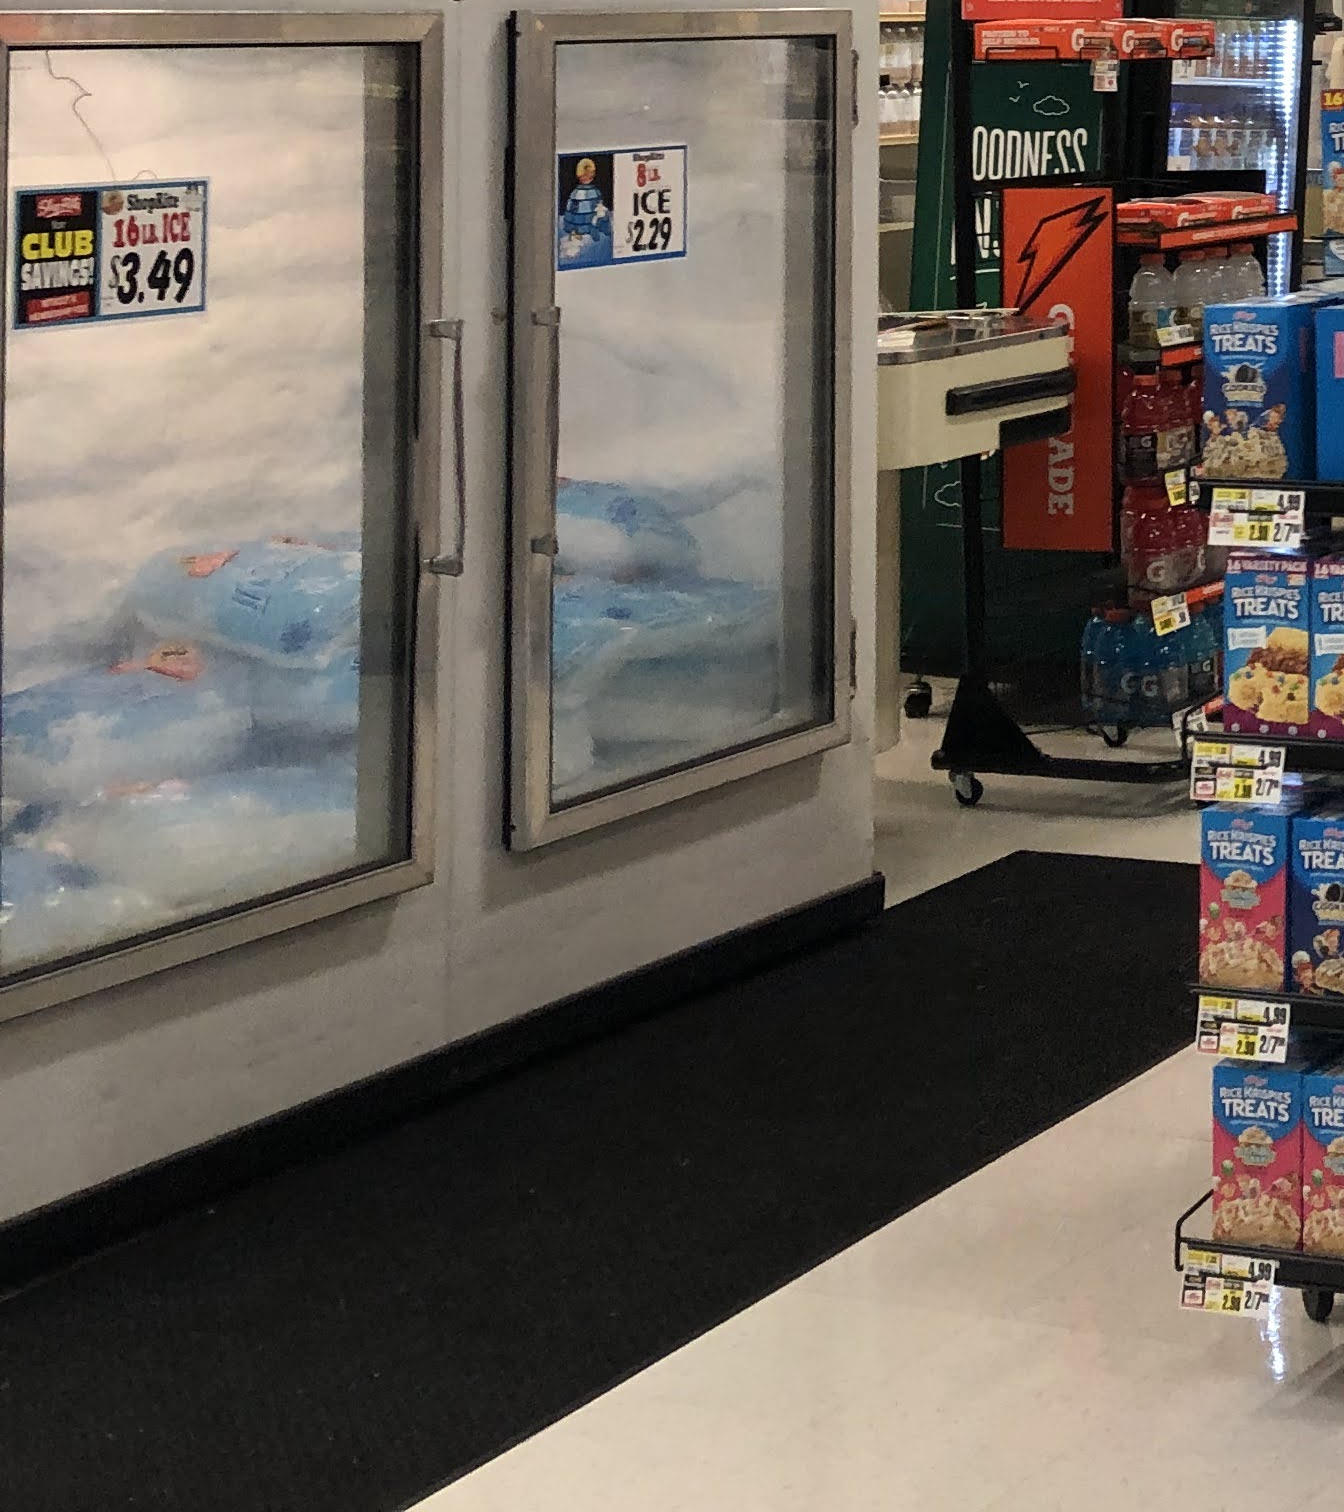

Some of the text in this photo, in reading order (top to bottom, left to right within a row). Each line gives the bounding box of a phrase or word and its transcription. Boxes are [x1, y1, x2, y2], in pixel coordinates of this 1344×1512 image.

[1325, 91, 1343, 105] 16
[633, 189, 671, 216] ICE
[22, 229, 94, 260] CLUB
[113, 215, 140, 248] 16
[162, 212, 191, 243] ICE
[108, 248, 195, 304] $3.49
[1212, 335, 1277, 354] TREATS
